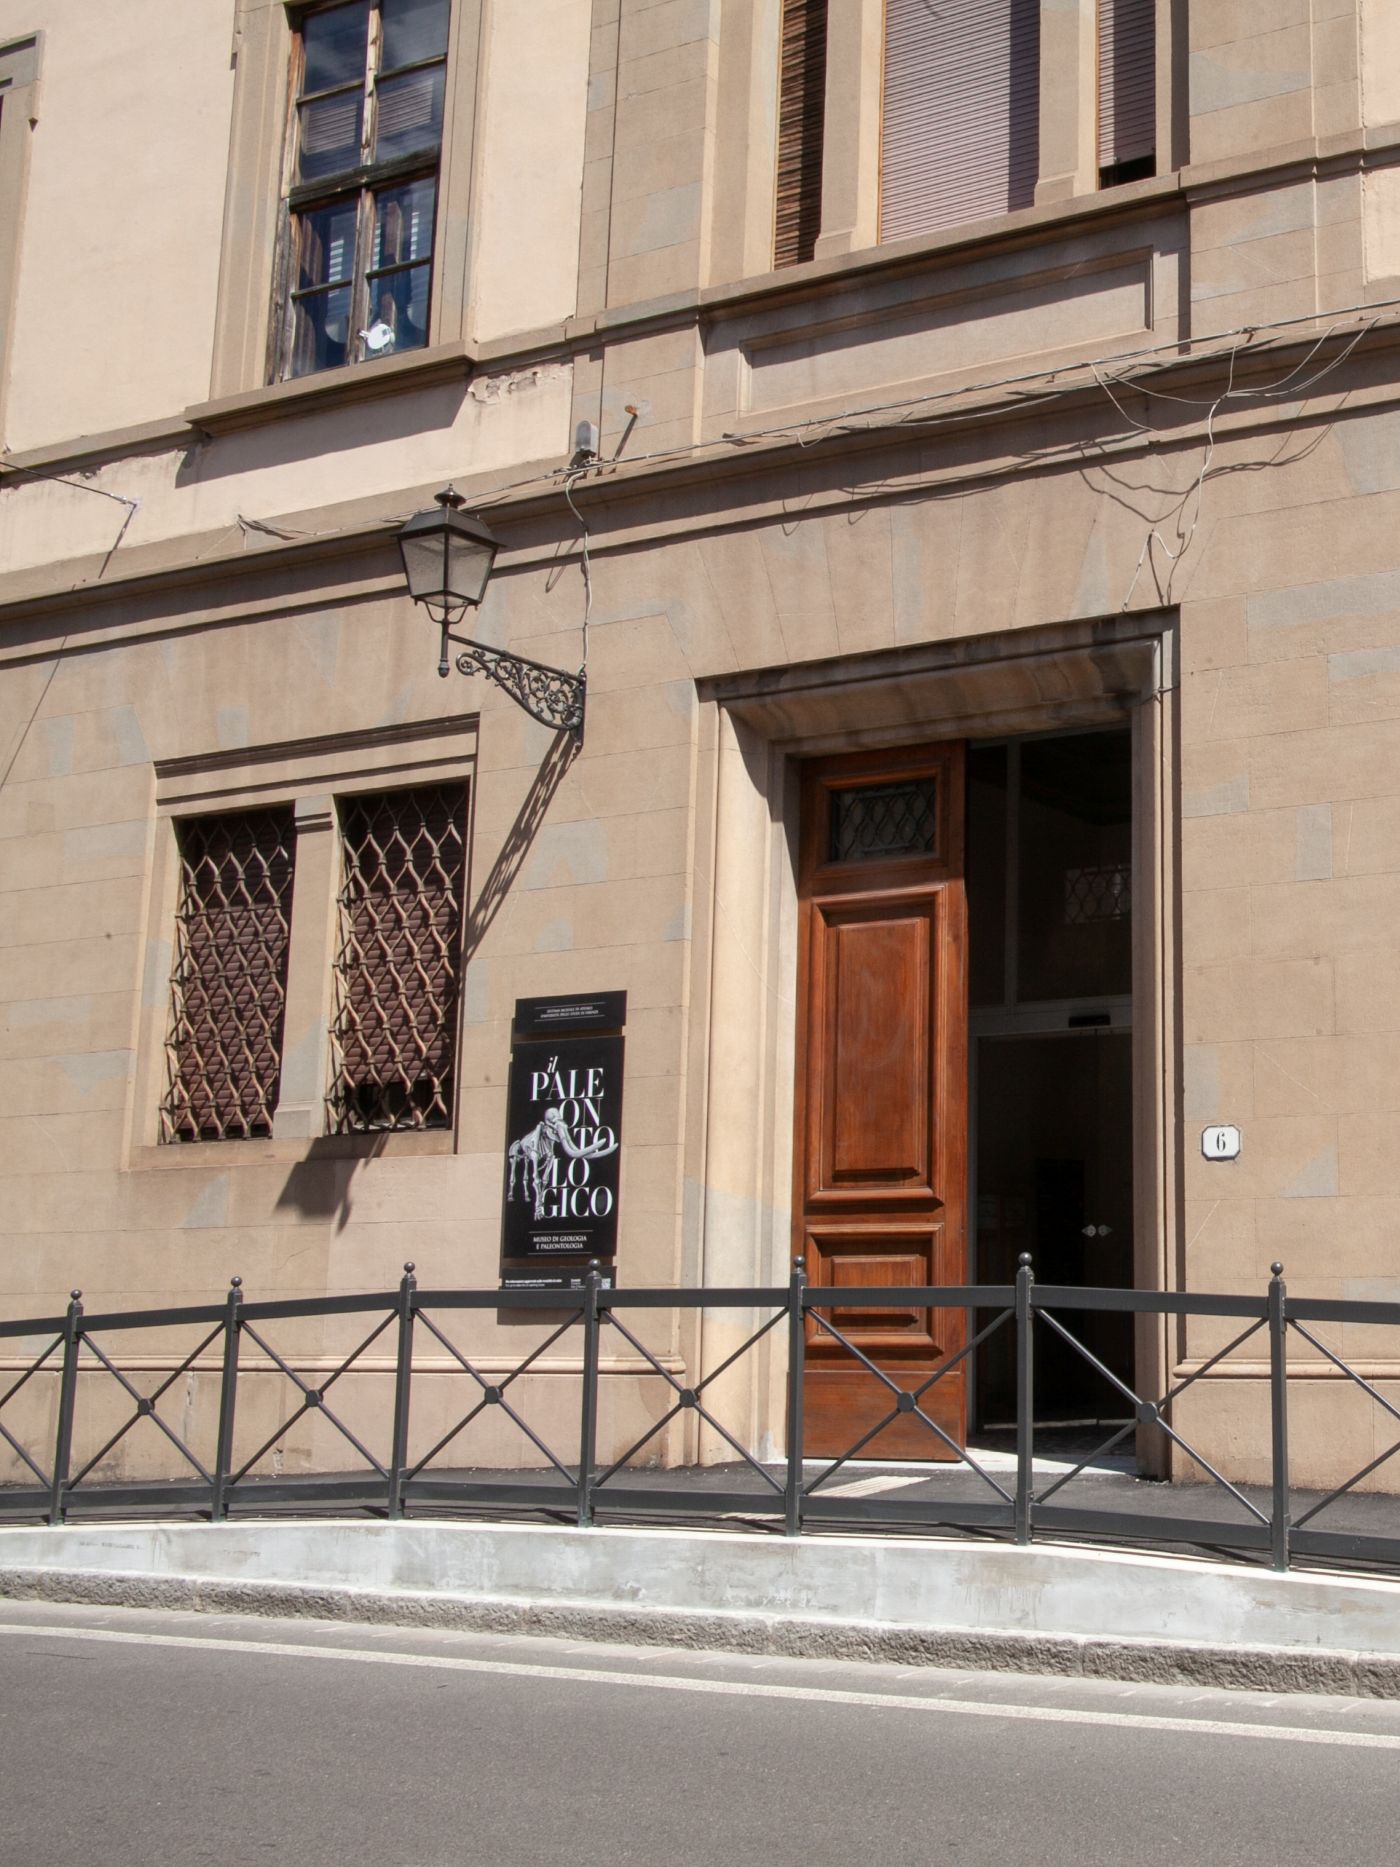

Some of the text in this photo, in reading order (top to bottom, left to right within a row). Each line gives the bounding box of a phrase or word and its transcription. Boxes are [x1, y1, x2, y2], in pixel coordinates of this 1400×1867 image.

[547, 1055, 559, 1074] il
[529, 1067, 605, 1101] PALE
[559, 1098, 604, 1129] ON
[573, 1126, 615, 1153] TO
[1216, 1131, 1226, 1153] 6
[549, 1157, 590, 1188] LO
[541, 1186, 613, 1218] GICO
